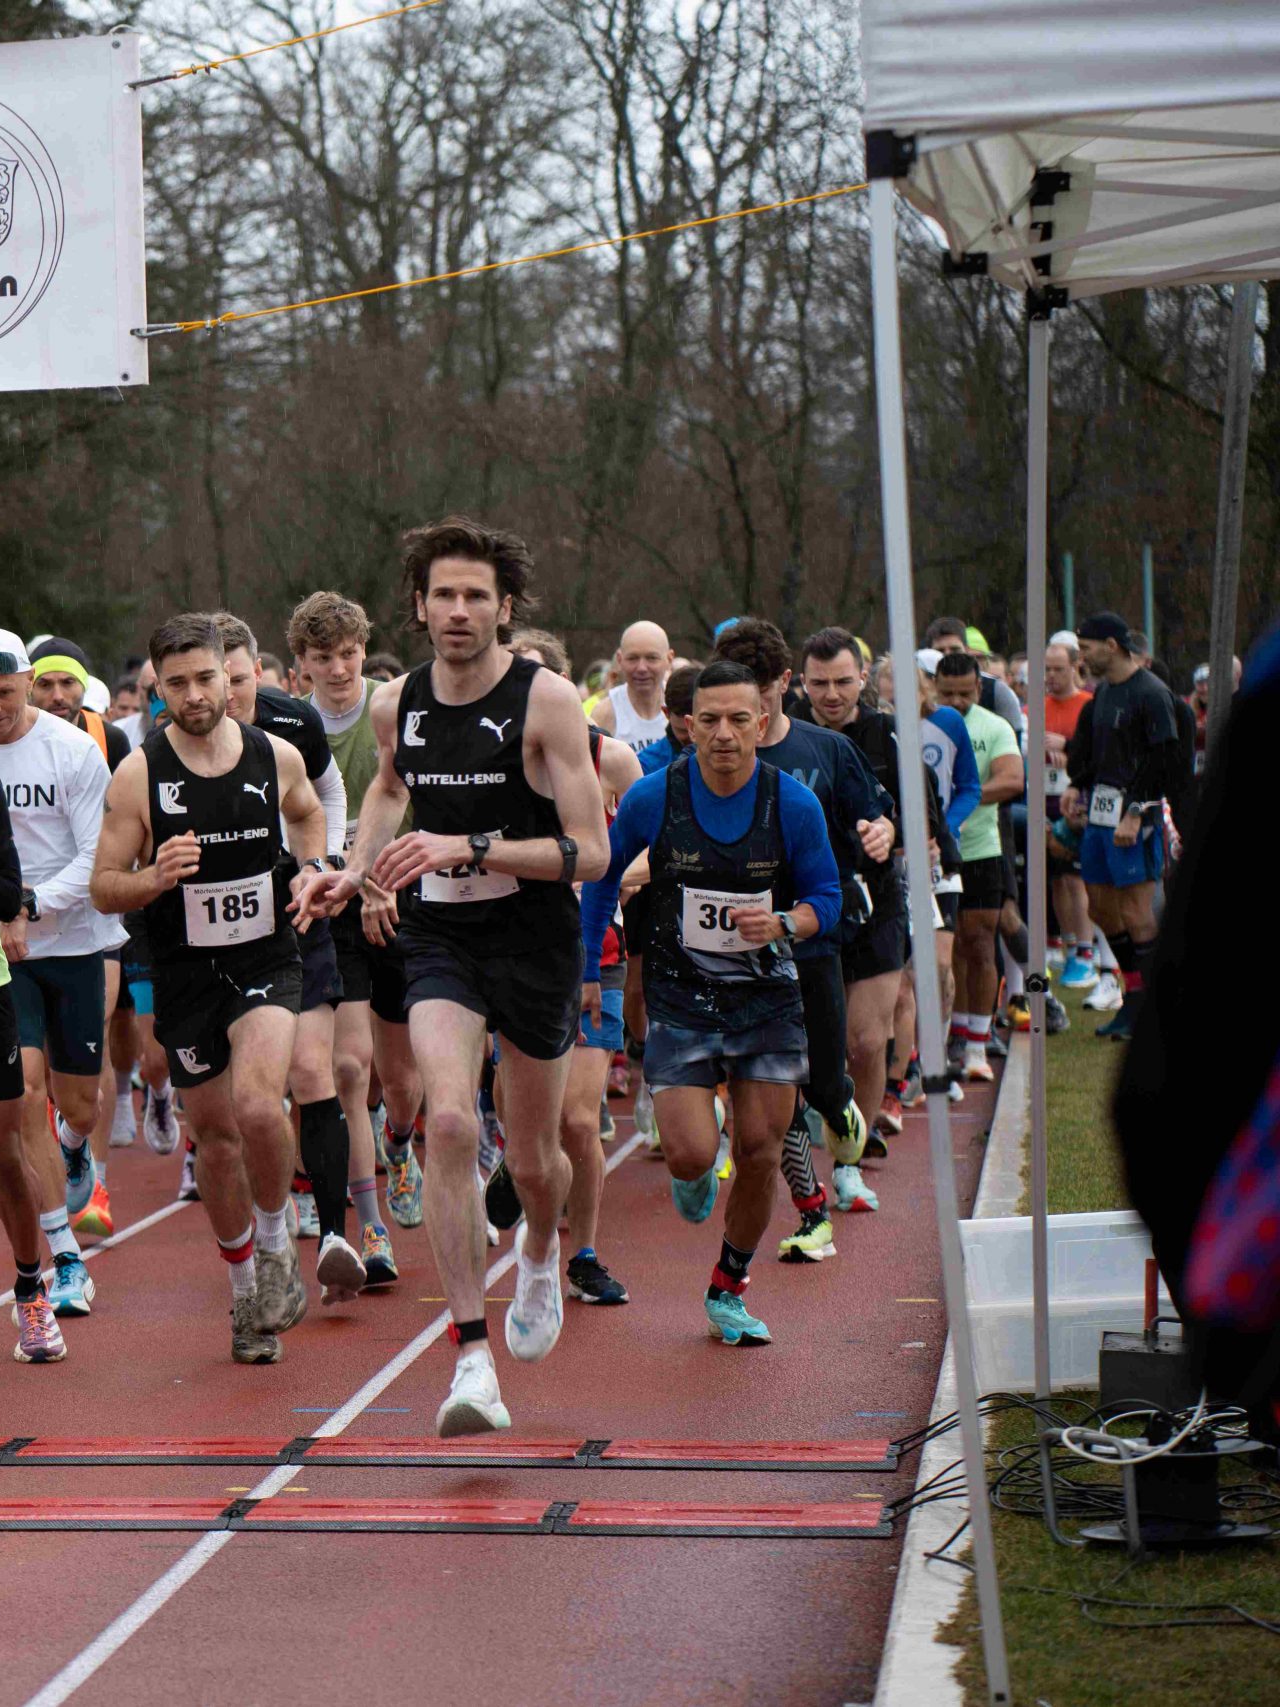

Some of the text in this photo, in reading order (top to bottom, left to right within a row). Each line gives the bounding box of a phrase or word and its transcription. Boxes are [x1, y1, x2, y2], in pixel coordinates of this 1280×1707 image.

[273, 716, 298, 725] CRAFT
[417, 773, 507, 785] INTELLI-ENG
[195, 828, 269, 845] NTELLI-ENG
[194, 880, 264, 895] Mörfelder Langlauftage
[202, 890, 260, 924] 185
[699, 903, 739, 932] 30
